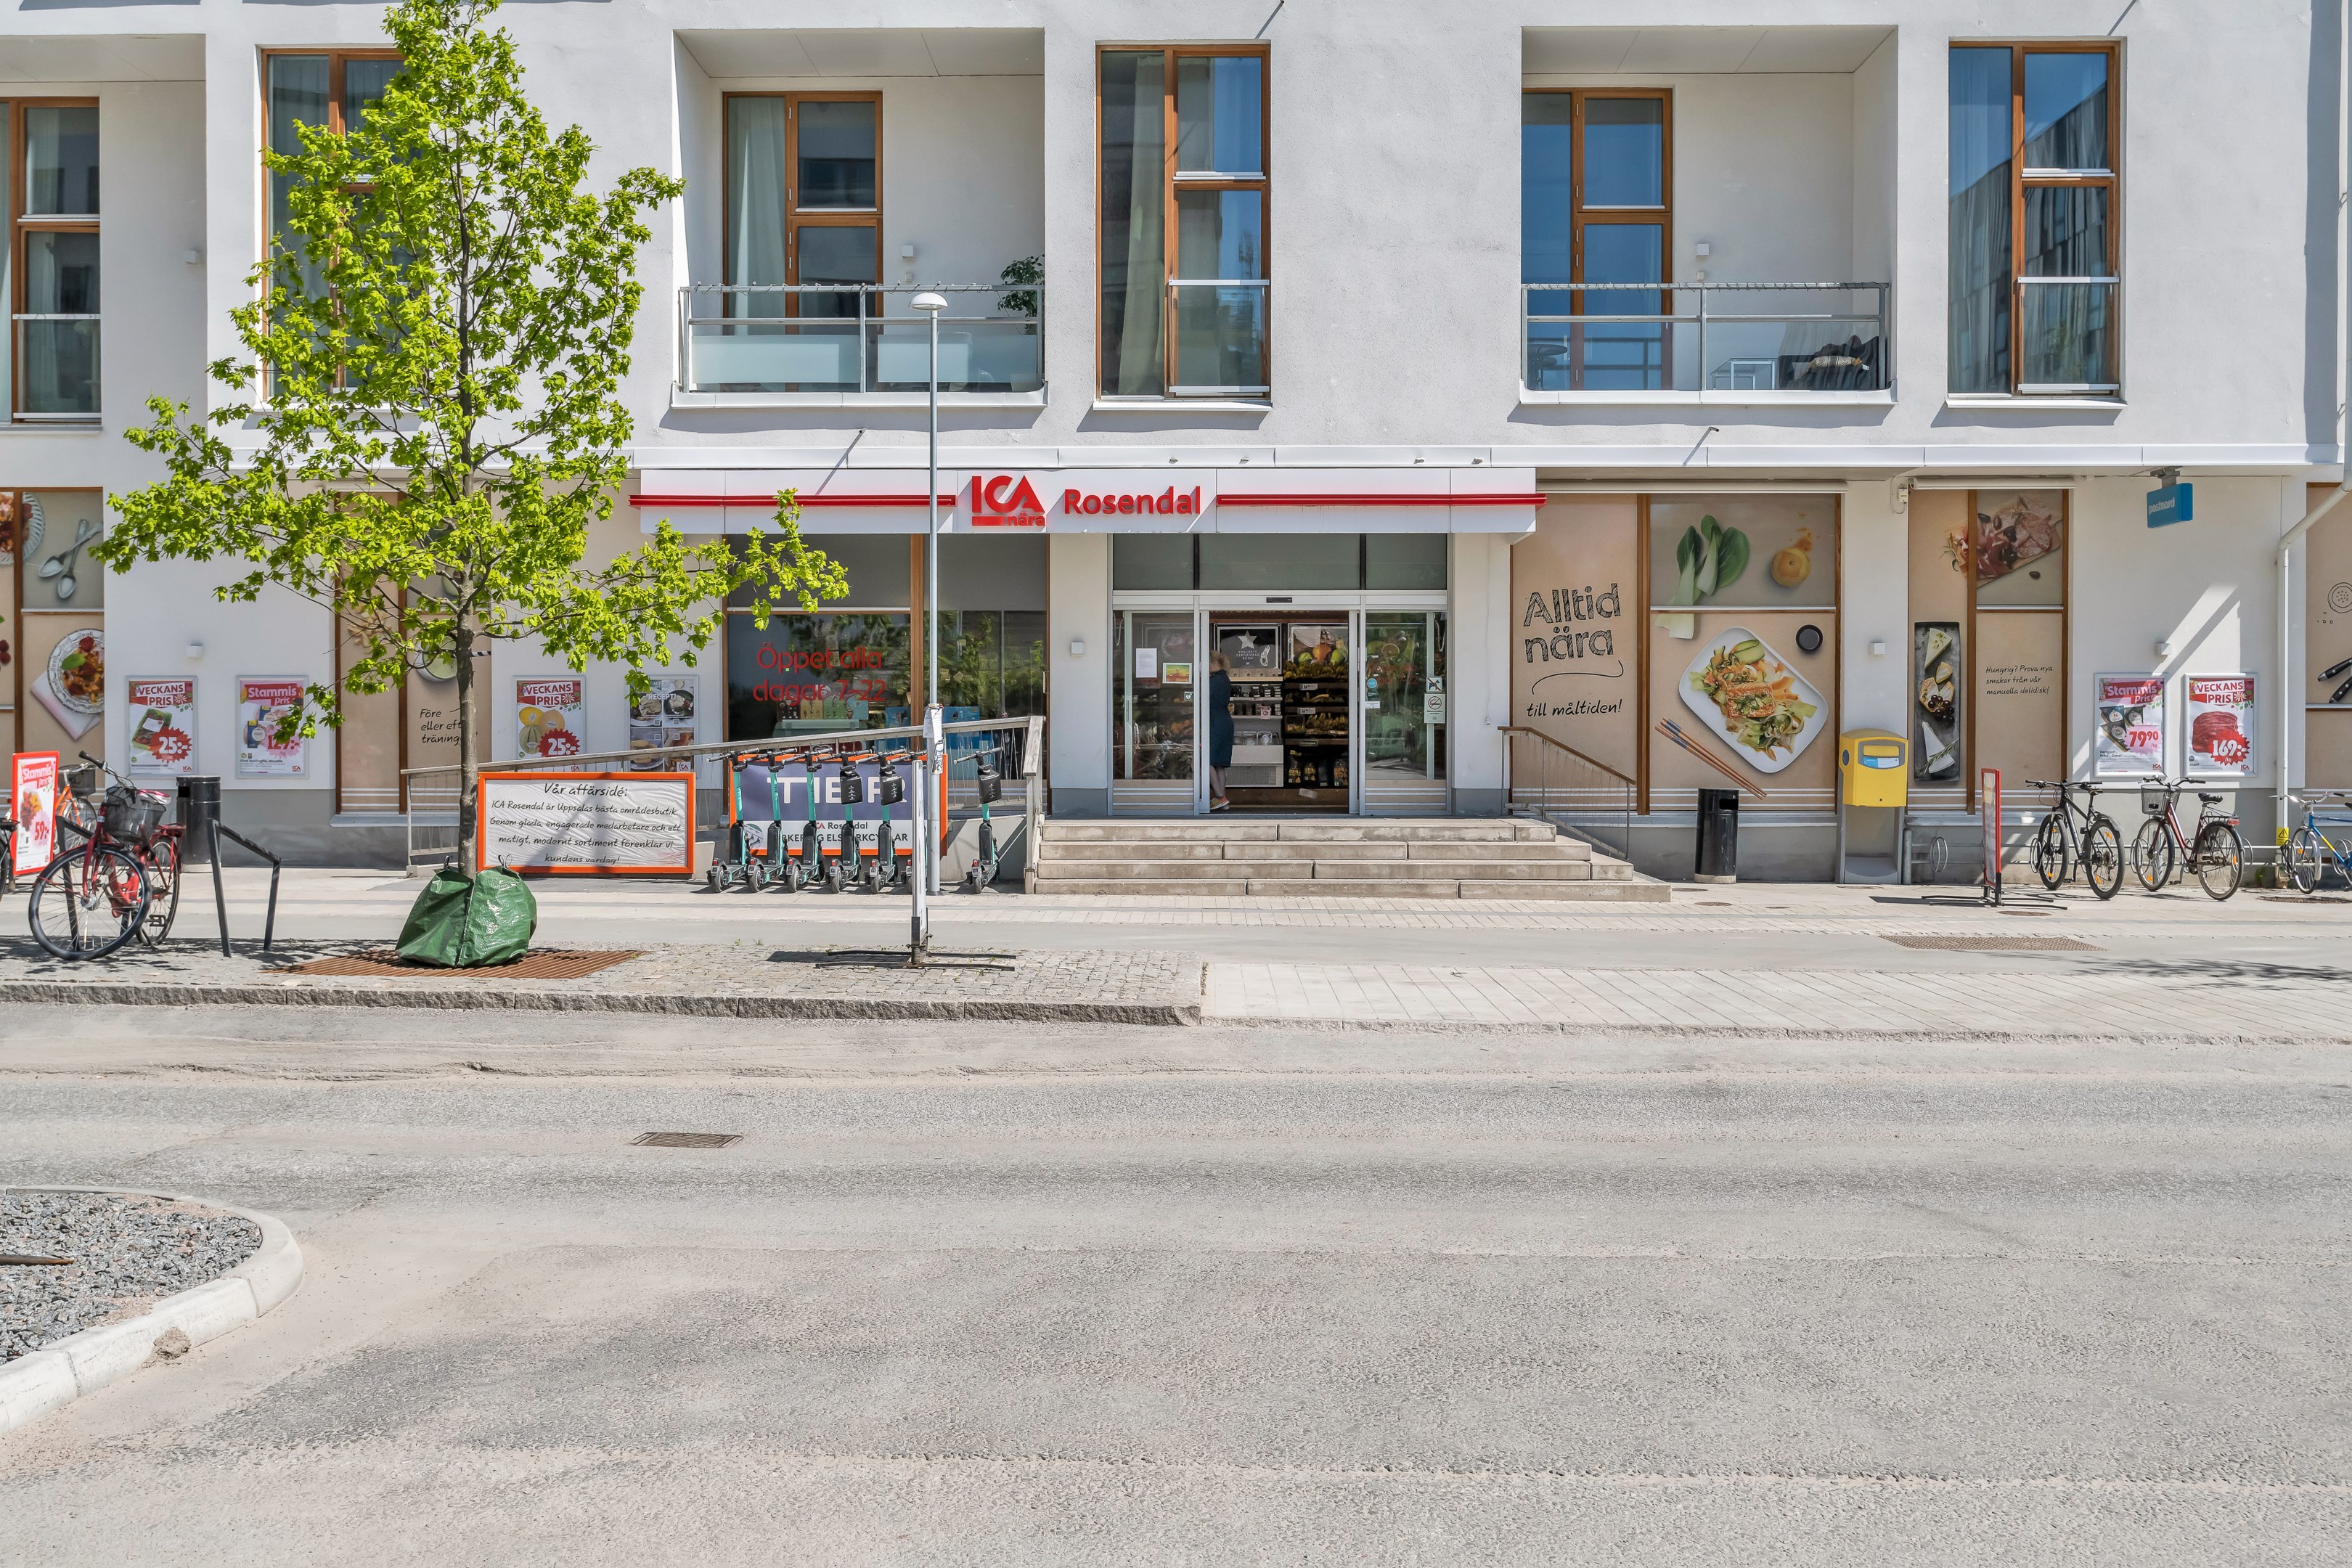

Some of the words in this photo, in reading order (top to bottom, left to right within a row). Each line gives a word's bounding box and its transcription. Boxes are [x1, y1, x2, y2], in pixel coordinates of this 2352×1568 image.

[971, 475, 1045, 513] ICA
[1064, 486, 1201, 515] Rosendal
[2148, 497, 2176, 516] postnord
[1007, 511, 1045, 526] nära
[1523, 583, 1621, 626] Alltid
[1524, 626, 1614, 663] nära
[756, 642, 833, 674] Öppet
[840, 645, 882, 669] alla
[1985, 665, 2018, 675] Hungrig?
[138, 685, 184, 695] VECKANS
[248, 686, 297, 698] Stammis
[526, 684, 571, 695] VECKANS
[753, 679, 825, 706] dagar
[2107, 682, 2157, 696] Stammis
[2197, 682, 2243, 693] VECKANS
[149, 696, 172, 706] PRIS
[274, 697, 290, 706] Pris
[536, 696, 560, 706] PRIS
[2134, 695, 2150, 704] Pris
[2208, 694, 2231, 703] PRIS
[420, 709, 442, 718] Före
[1527, 702, 1547, 717] till
[1552, 698, 1622, 716] måltiden!
[421, 720, 444, 731] eller
[446, 719, 462, 730] eft
[158, 736, 188, 754] 25:-
[422, 733, 461, 746] träning
[547, 738, 576, 756] 25:-
[2213, 739, 2247, 756] 169:-
[23, 765, 52, 780] Stammis
[38, 777, 49, 789] Pris
[544, 783, 566, 794] Vår
[568, 784, 628, 797] affärsidé:
[491, 799, 505, 809] ICA
[507, 801, 544, 810] Rosendal
[557, 803, 593, 813] Uppsalas
[595, 804, 618, 813] bästa
[620, 806, 678, 816] områdesbutik.
[490, 817, 517, 825] Genom
[546, 820, 595, 831] engagerade
[596, 821, 650, 830] medarbetare
[498, 835, 531, 846] matigt,
[534, 836, 572, 845] modernt
[573, 837, 618, 847] sortiment
[621, 839, 663, 848] förenklar
[544, 853, 583, 862] kundens
[586, 855, 621, 865] vardag!
